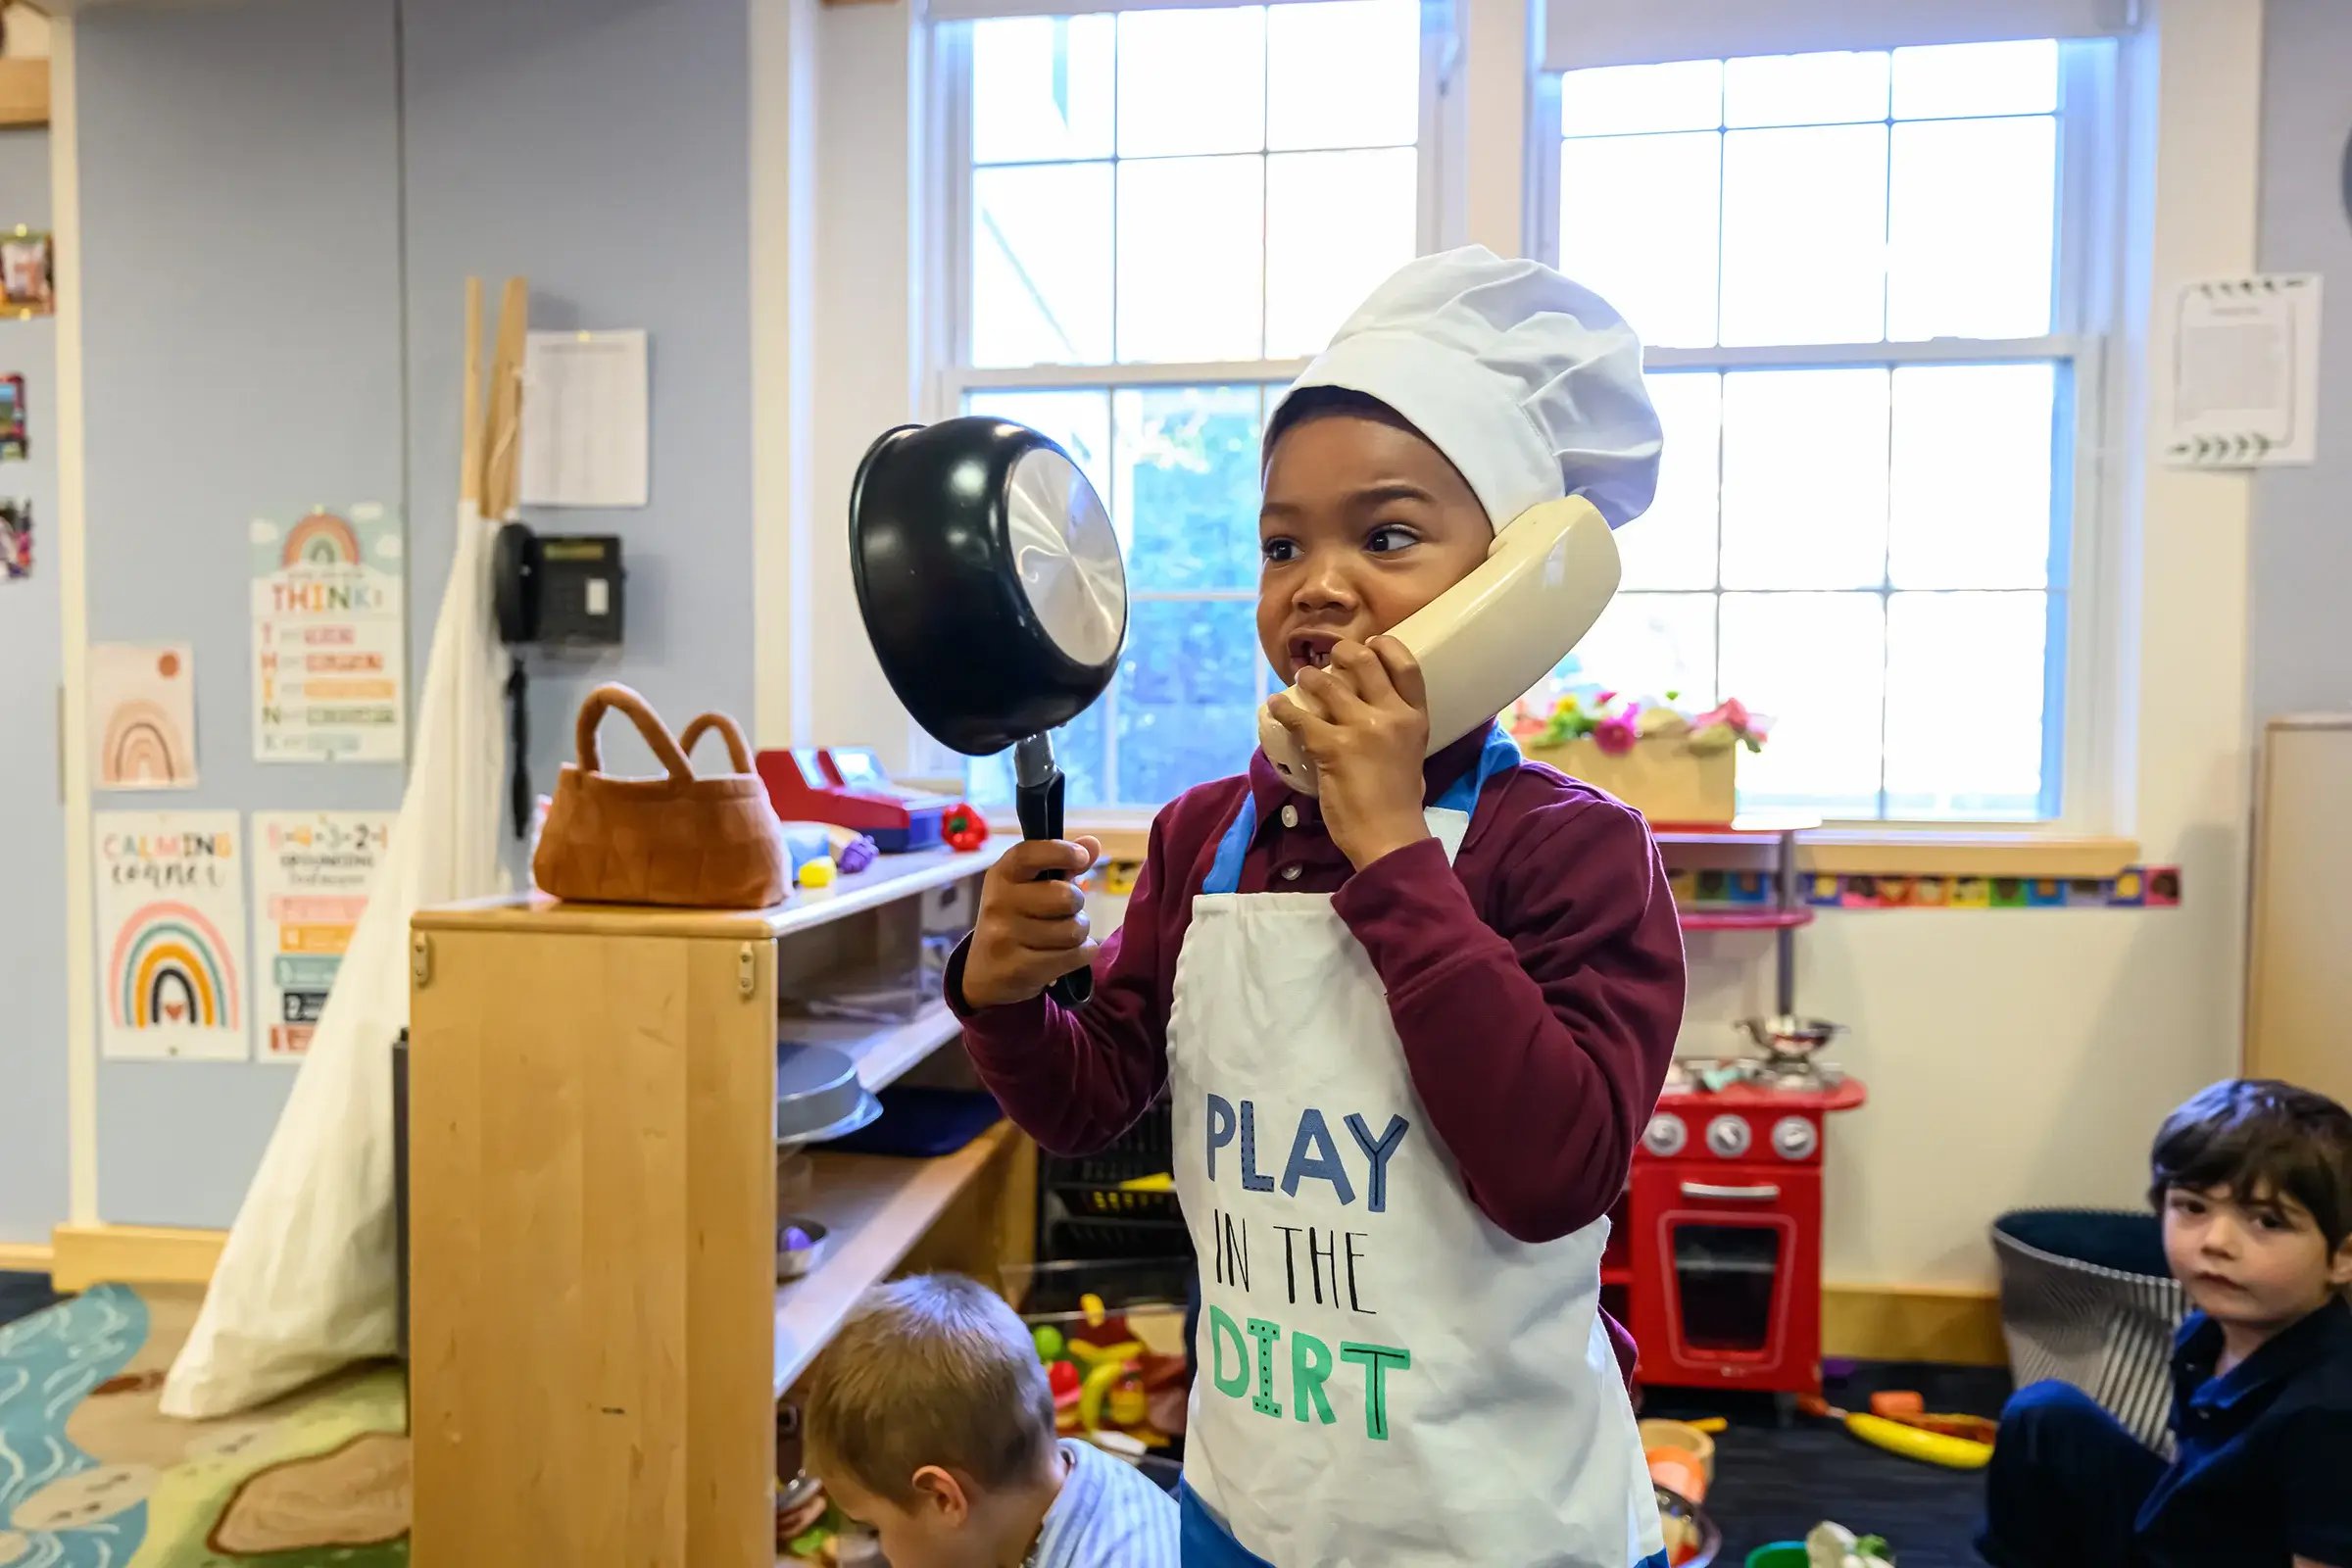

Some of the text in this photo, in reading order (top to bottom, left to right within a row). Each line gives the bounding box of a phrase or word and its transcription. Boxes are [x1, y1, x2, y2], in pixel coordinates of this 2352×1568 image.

[103, 833, 232, 861] CALMING
[1206, 1093, 1409, 1213] PLAY
[1214, 1208, 1377, 1315] IN THE
[1209, 1304, 1411, 1442] DIRT
